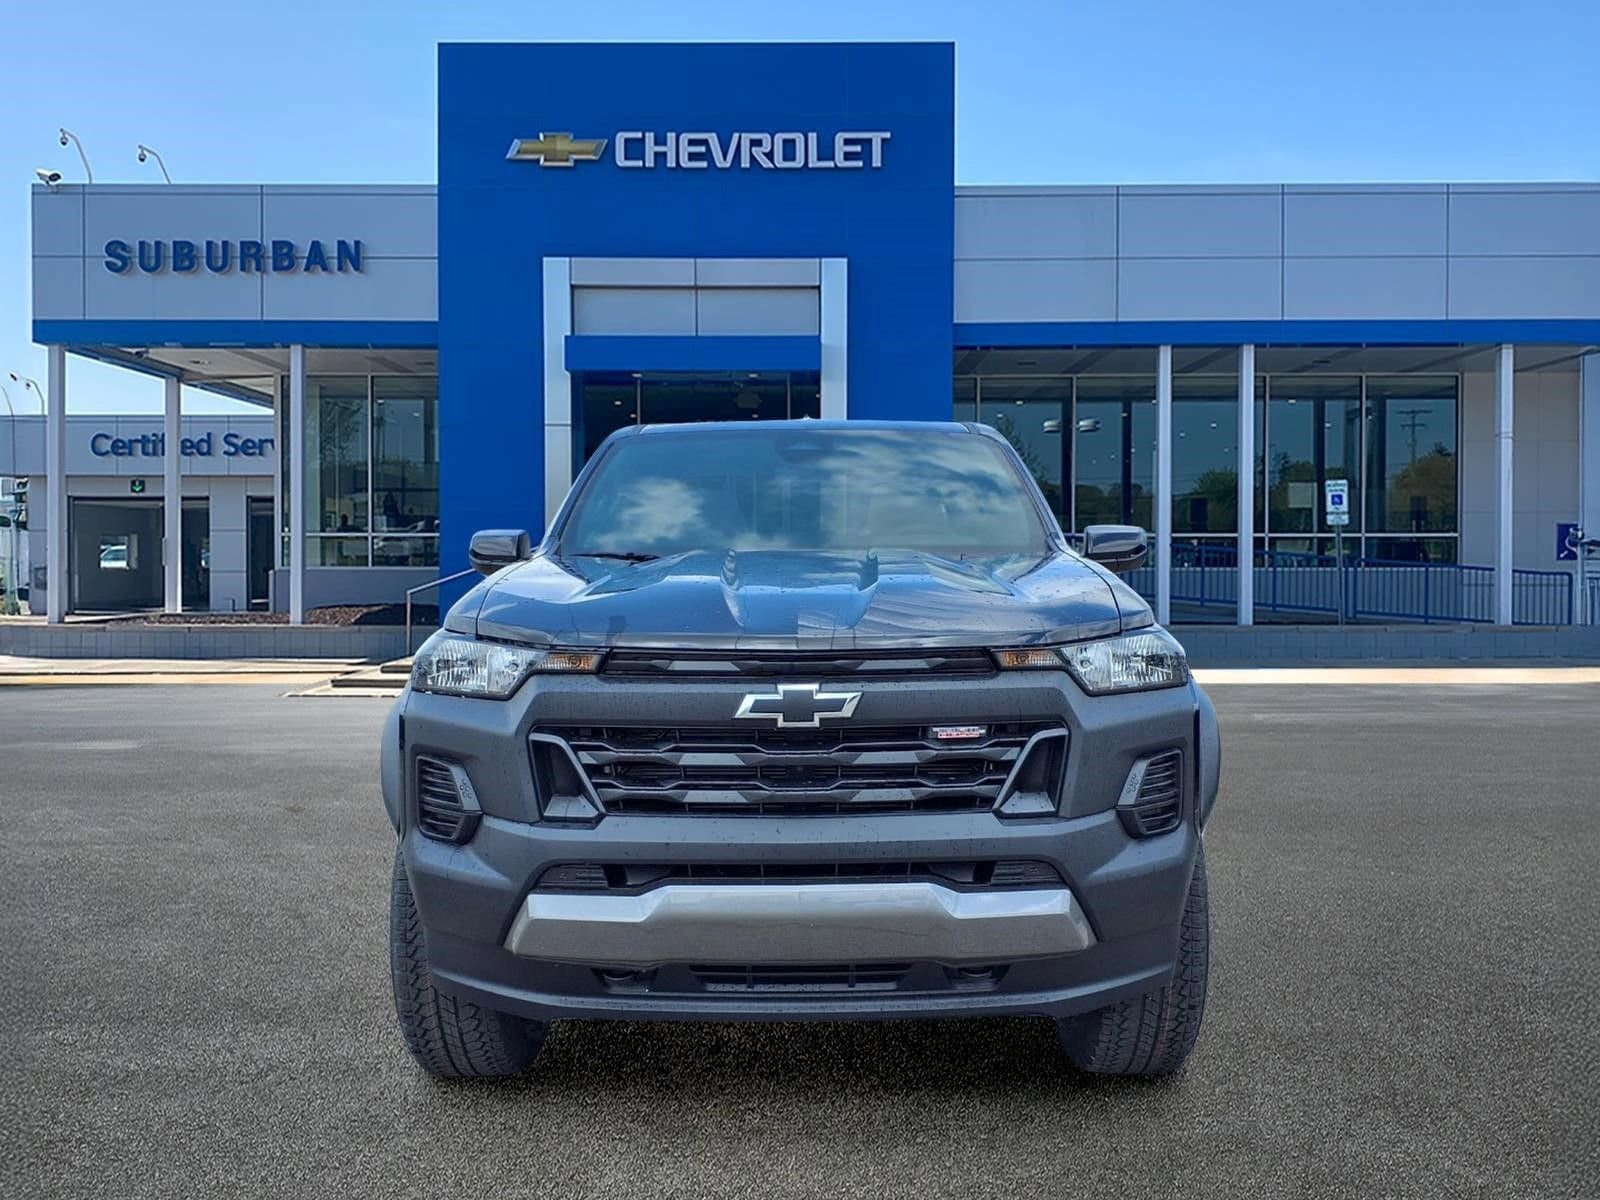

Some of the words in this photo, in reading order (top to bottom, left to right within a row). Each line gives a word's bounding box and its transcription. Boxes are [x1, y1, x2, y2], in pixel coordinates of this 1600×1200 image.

[614, 130, 892, 169] CHEVROLET
[104, 239, 362, 273] SUBURBAN
[90, 431, 212, 457] Certifed
